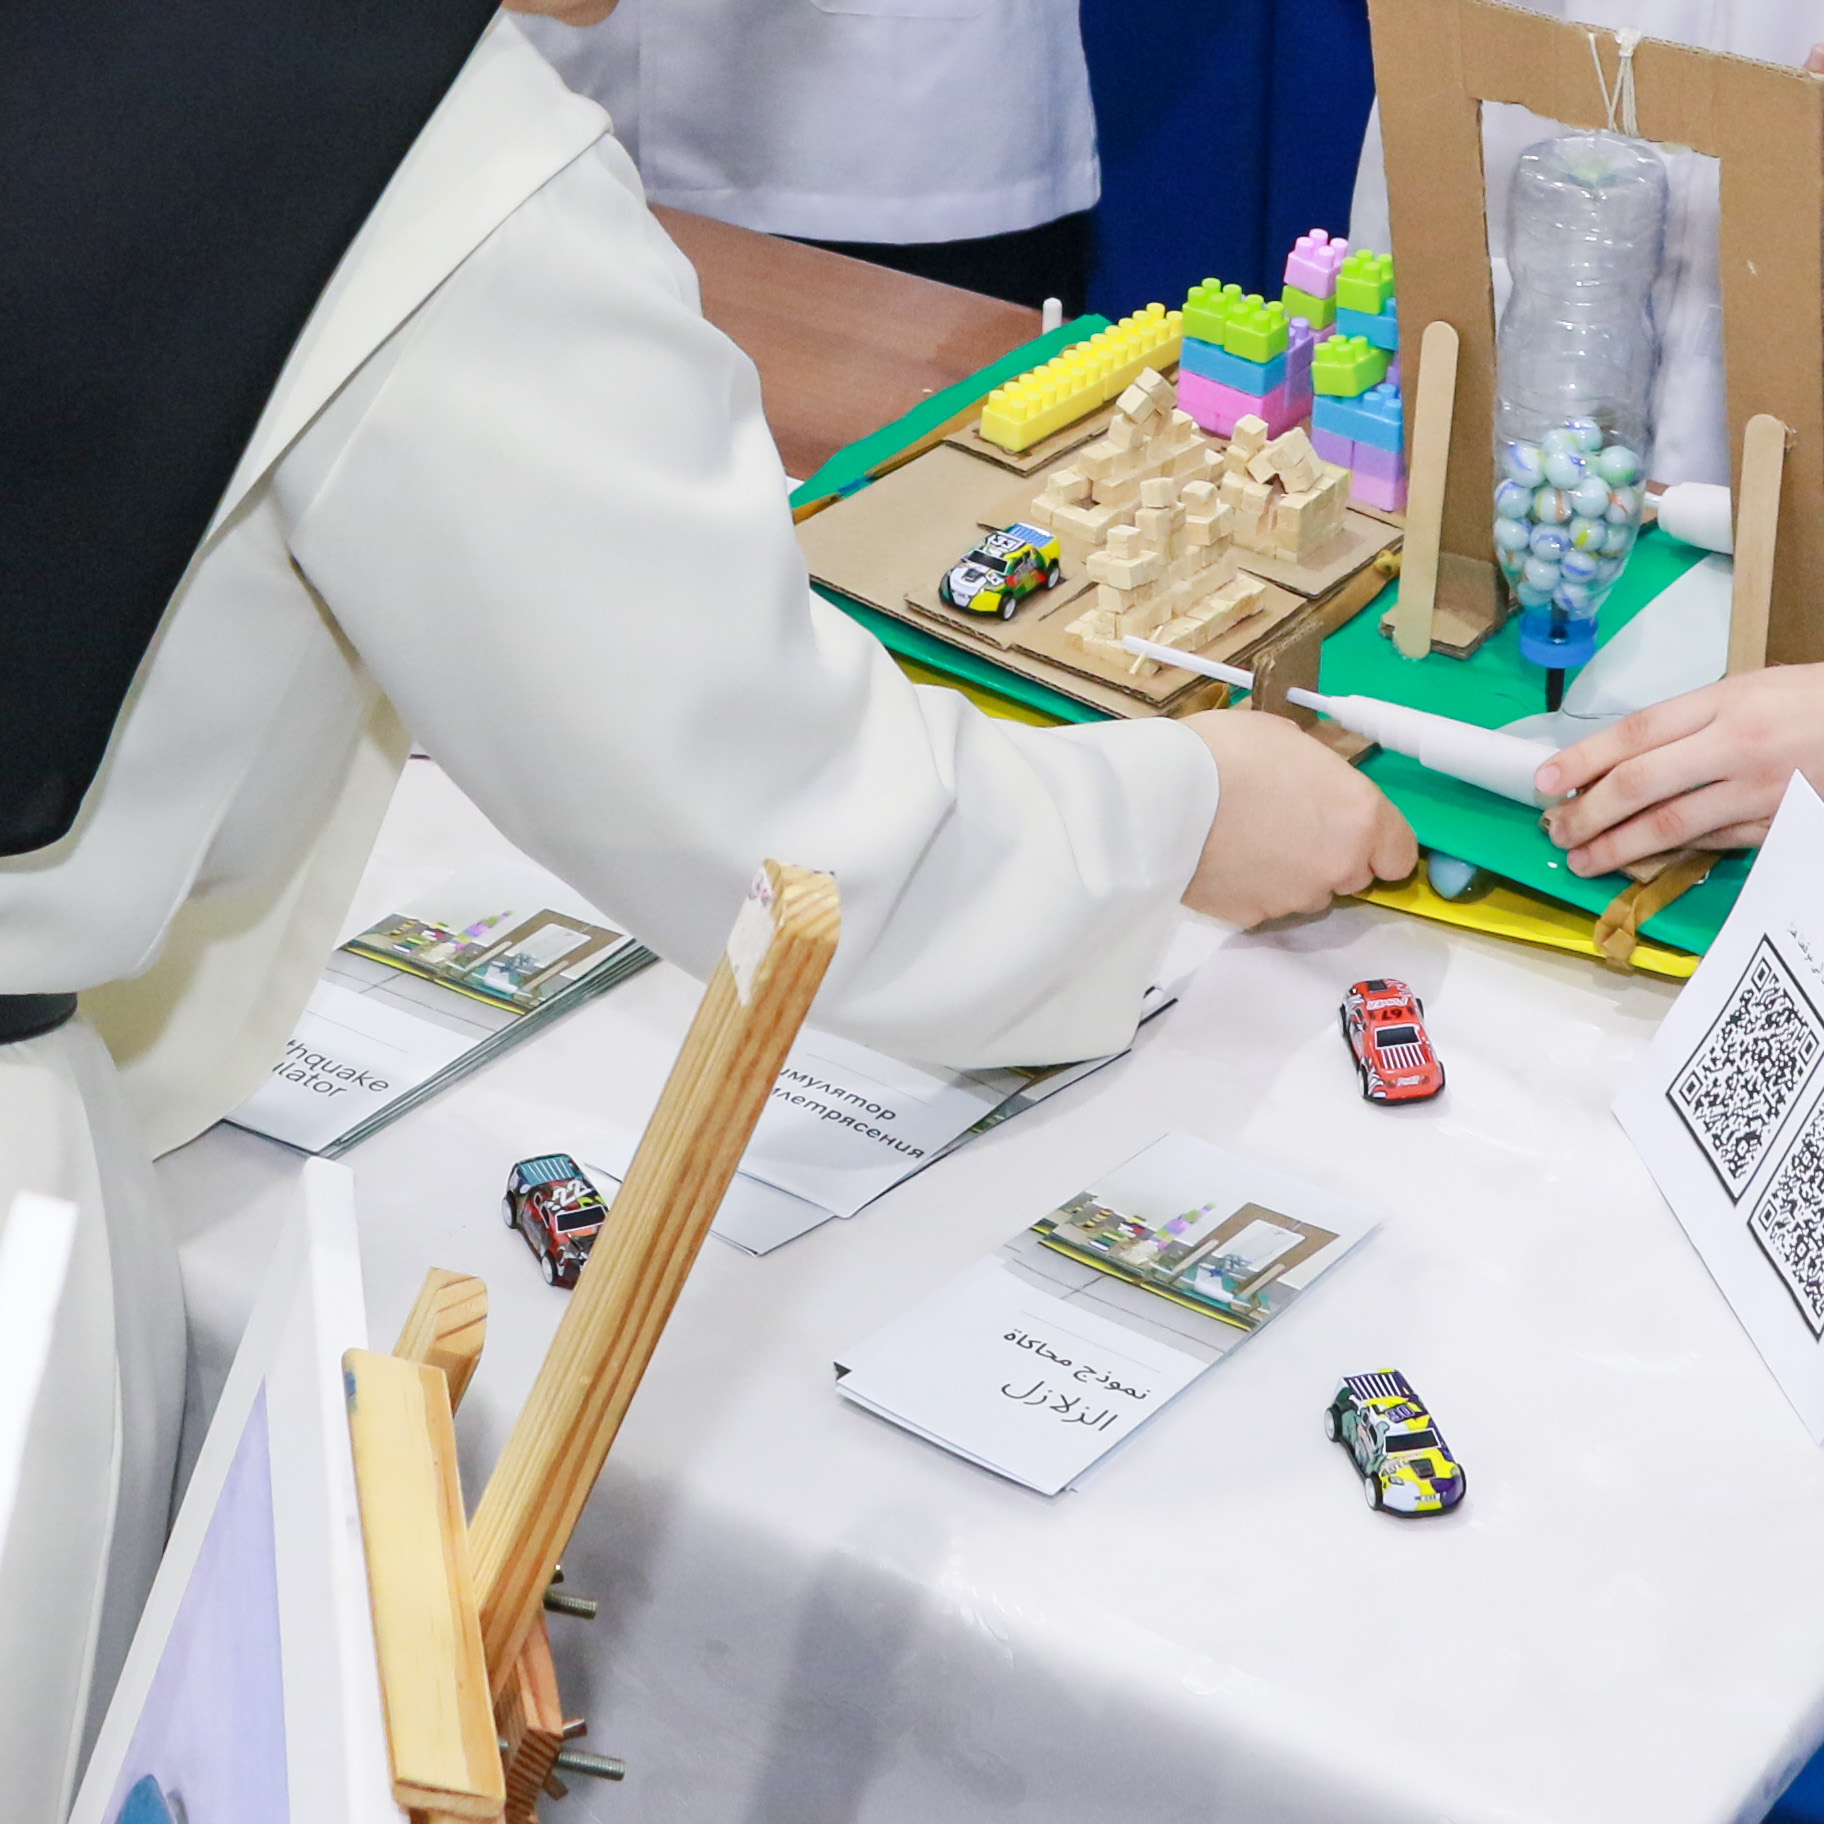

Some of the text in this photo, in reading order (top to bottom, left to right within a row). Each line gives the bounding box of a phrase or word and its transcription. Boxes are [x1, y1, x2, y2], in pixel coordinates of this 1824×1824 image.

[1003, 1328, 1151, 1401] نموذج محاكاة
[1001, 1380, 1118, 1432] الزلازل
